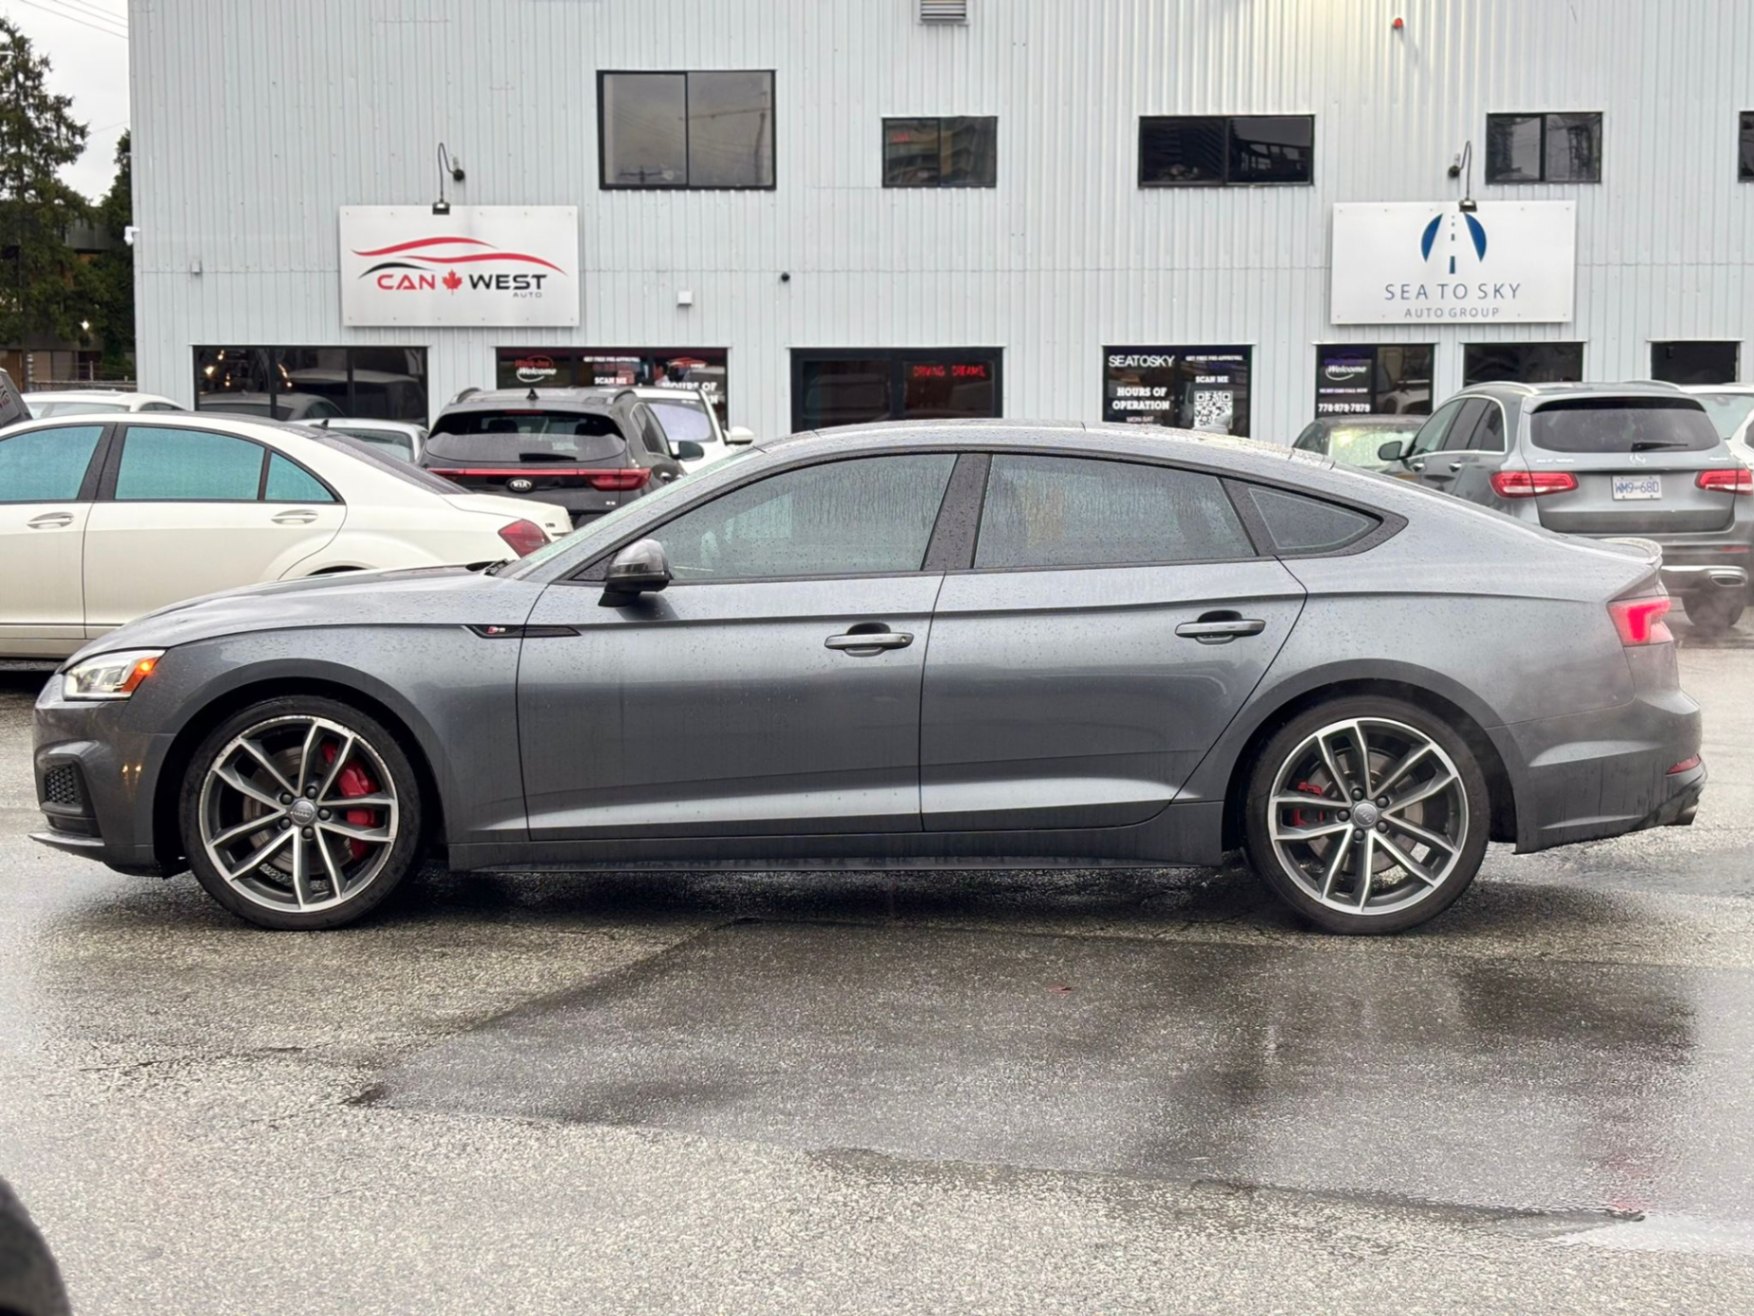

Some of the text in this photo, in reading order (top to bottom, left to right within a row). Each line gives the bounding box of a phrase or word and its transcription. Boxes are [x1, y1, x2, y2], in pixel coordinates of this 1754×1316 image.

[376, 274, 548, 290] CAN WEST
[1384, 283, 1521, 300] SEA TO SKY
[1404, 307, 1500, 318] AUTO GROUP
[1108, 355, 1175, 368] SEATOSKY
[594, 376, 615, 384] SCAN
[1195, 375, 1229, 383] SCAN ME
[702, 382, 718, 391] OF
[1117, 387, 1168, 397] HOURS OF
[1112, 400, 1170, 410] OPERATION
